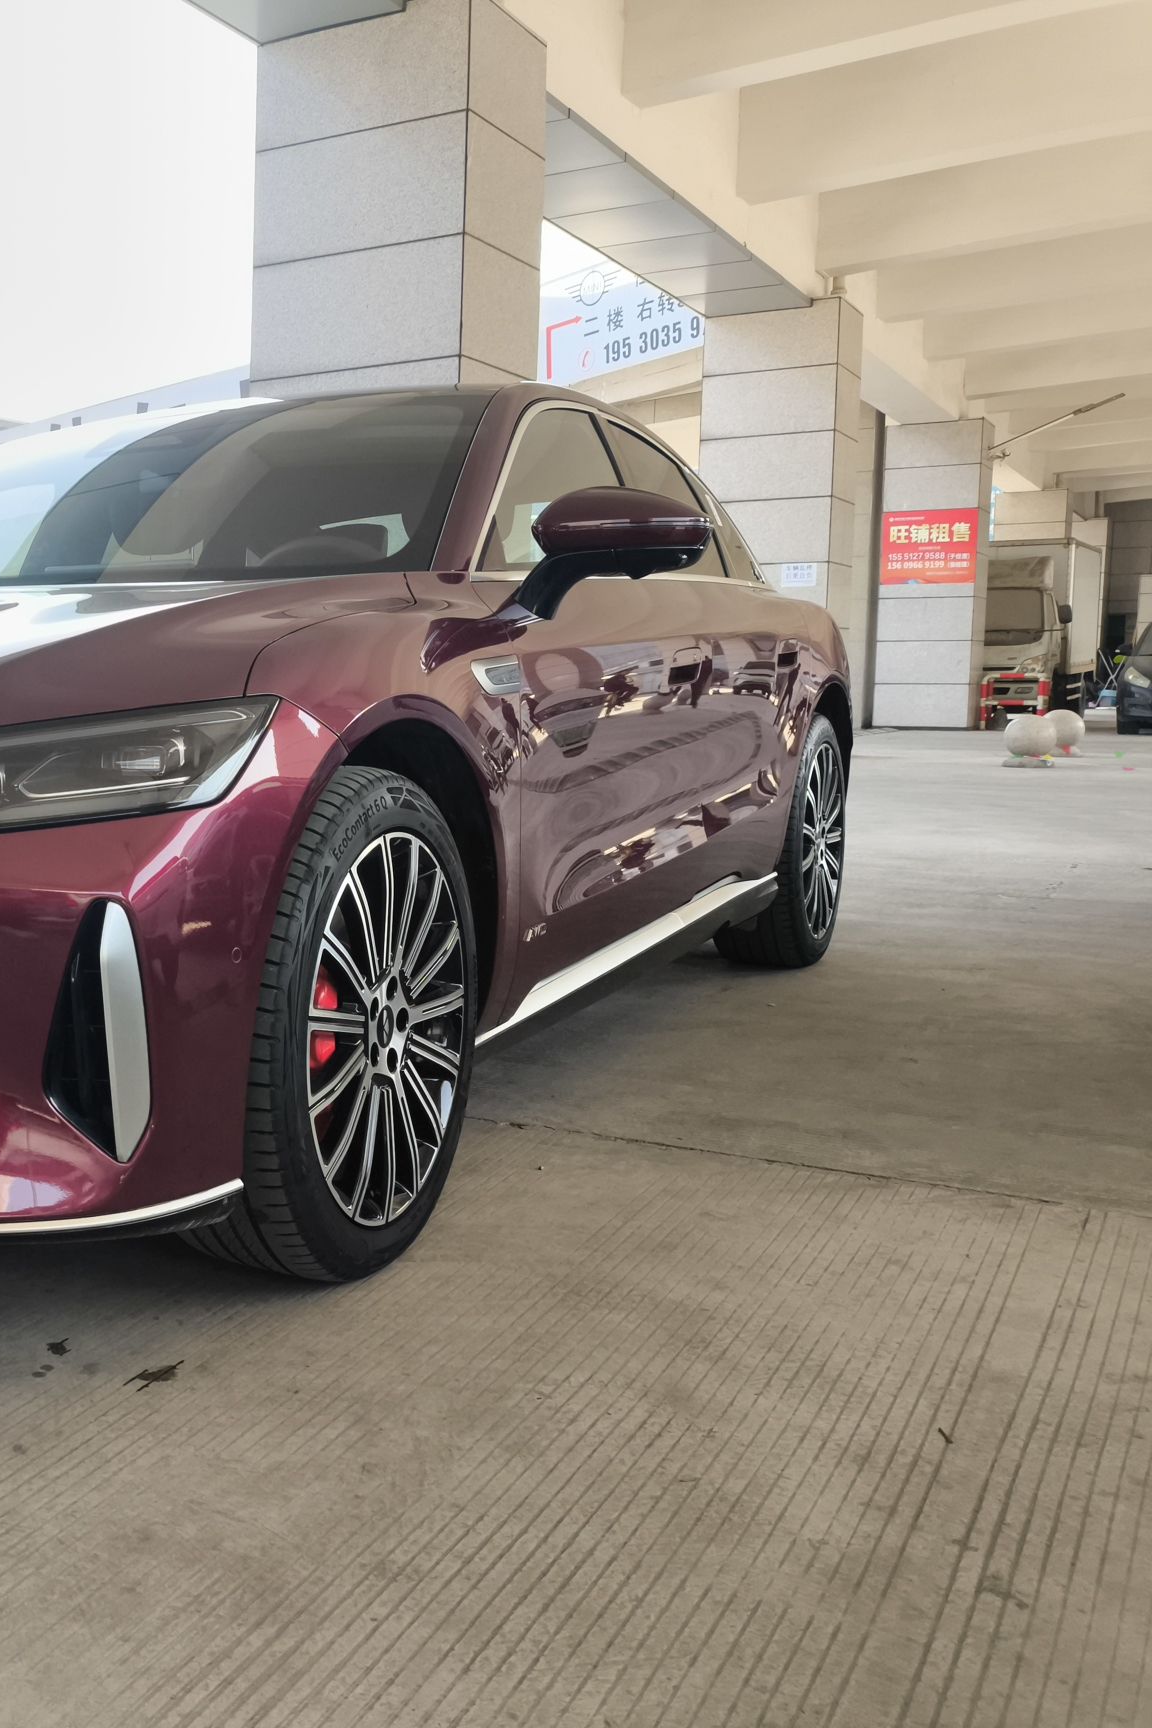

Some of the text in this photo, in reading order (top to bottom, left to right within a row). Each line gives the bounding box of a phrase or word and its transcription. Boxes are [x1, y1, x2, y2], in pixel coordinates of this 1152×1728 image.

[584, 292, 685, 338] 二楼 右转
[604, 336, 632, 364] 195
[639, 321, 682, 354] 3035
[889, 522, 971, 543] 旺铺租售
[887, 562, 903, 570] 156
[904, 561, 923, 569] 0966
[925, 560, 945, 569] 9199
[888, 553, 903, 561] 155
[904, 552, 923, 560] 5127
[925, 551, 946, 560] 9588
[332, 803, 375, 862] EcoContact
